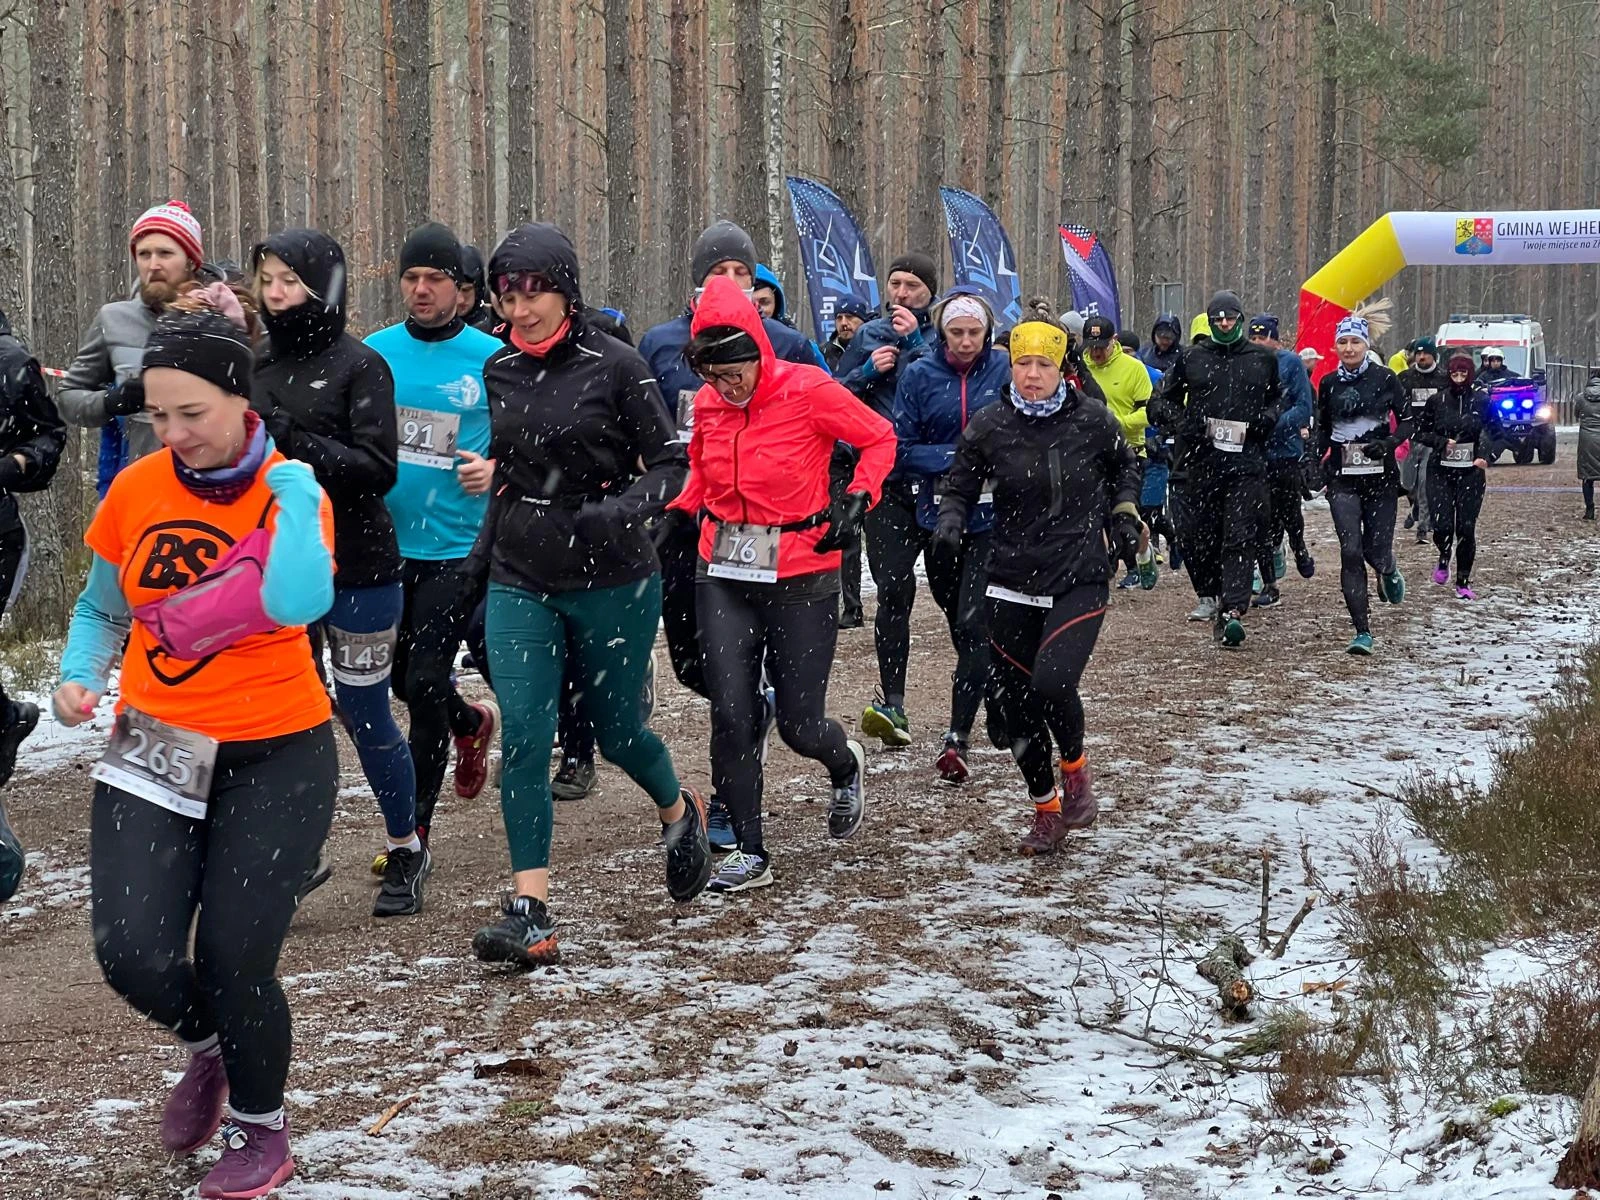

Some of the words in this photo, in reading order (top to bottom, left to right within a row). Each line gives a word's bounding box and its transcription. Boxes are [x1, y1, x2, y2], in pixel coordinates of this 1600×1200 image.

[1497, 222, 1544, 236] GMINA
[1548, 221, 1600, 235] WEJHE
[1523, 241, 1546, 250] Twoje
[1548, 240, 1579, 250] miejsce
[1580, 241, 1591, 249] na
[403, 420, 434, 448] 91
[1215, 427, 1233, 441] 81
[1446, 449, 1469, 460] 237
[728, 536, 758, 563] 76
[340, 643, 389, 669] 143
[122, 727, 193, 785] 265
